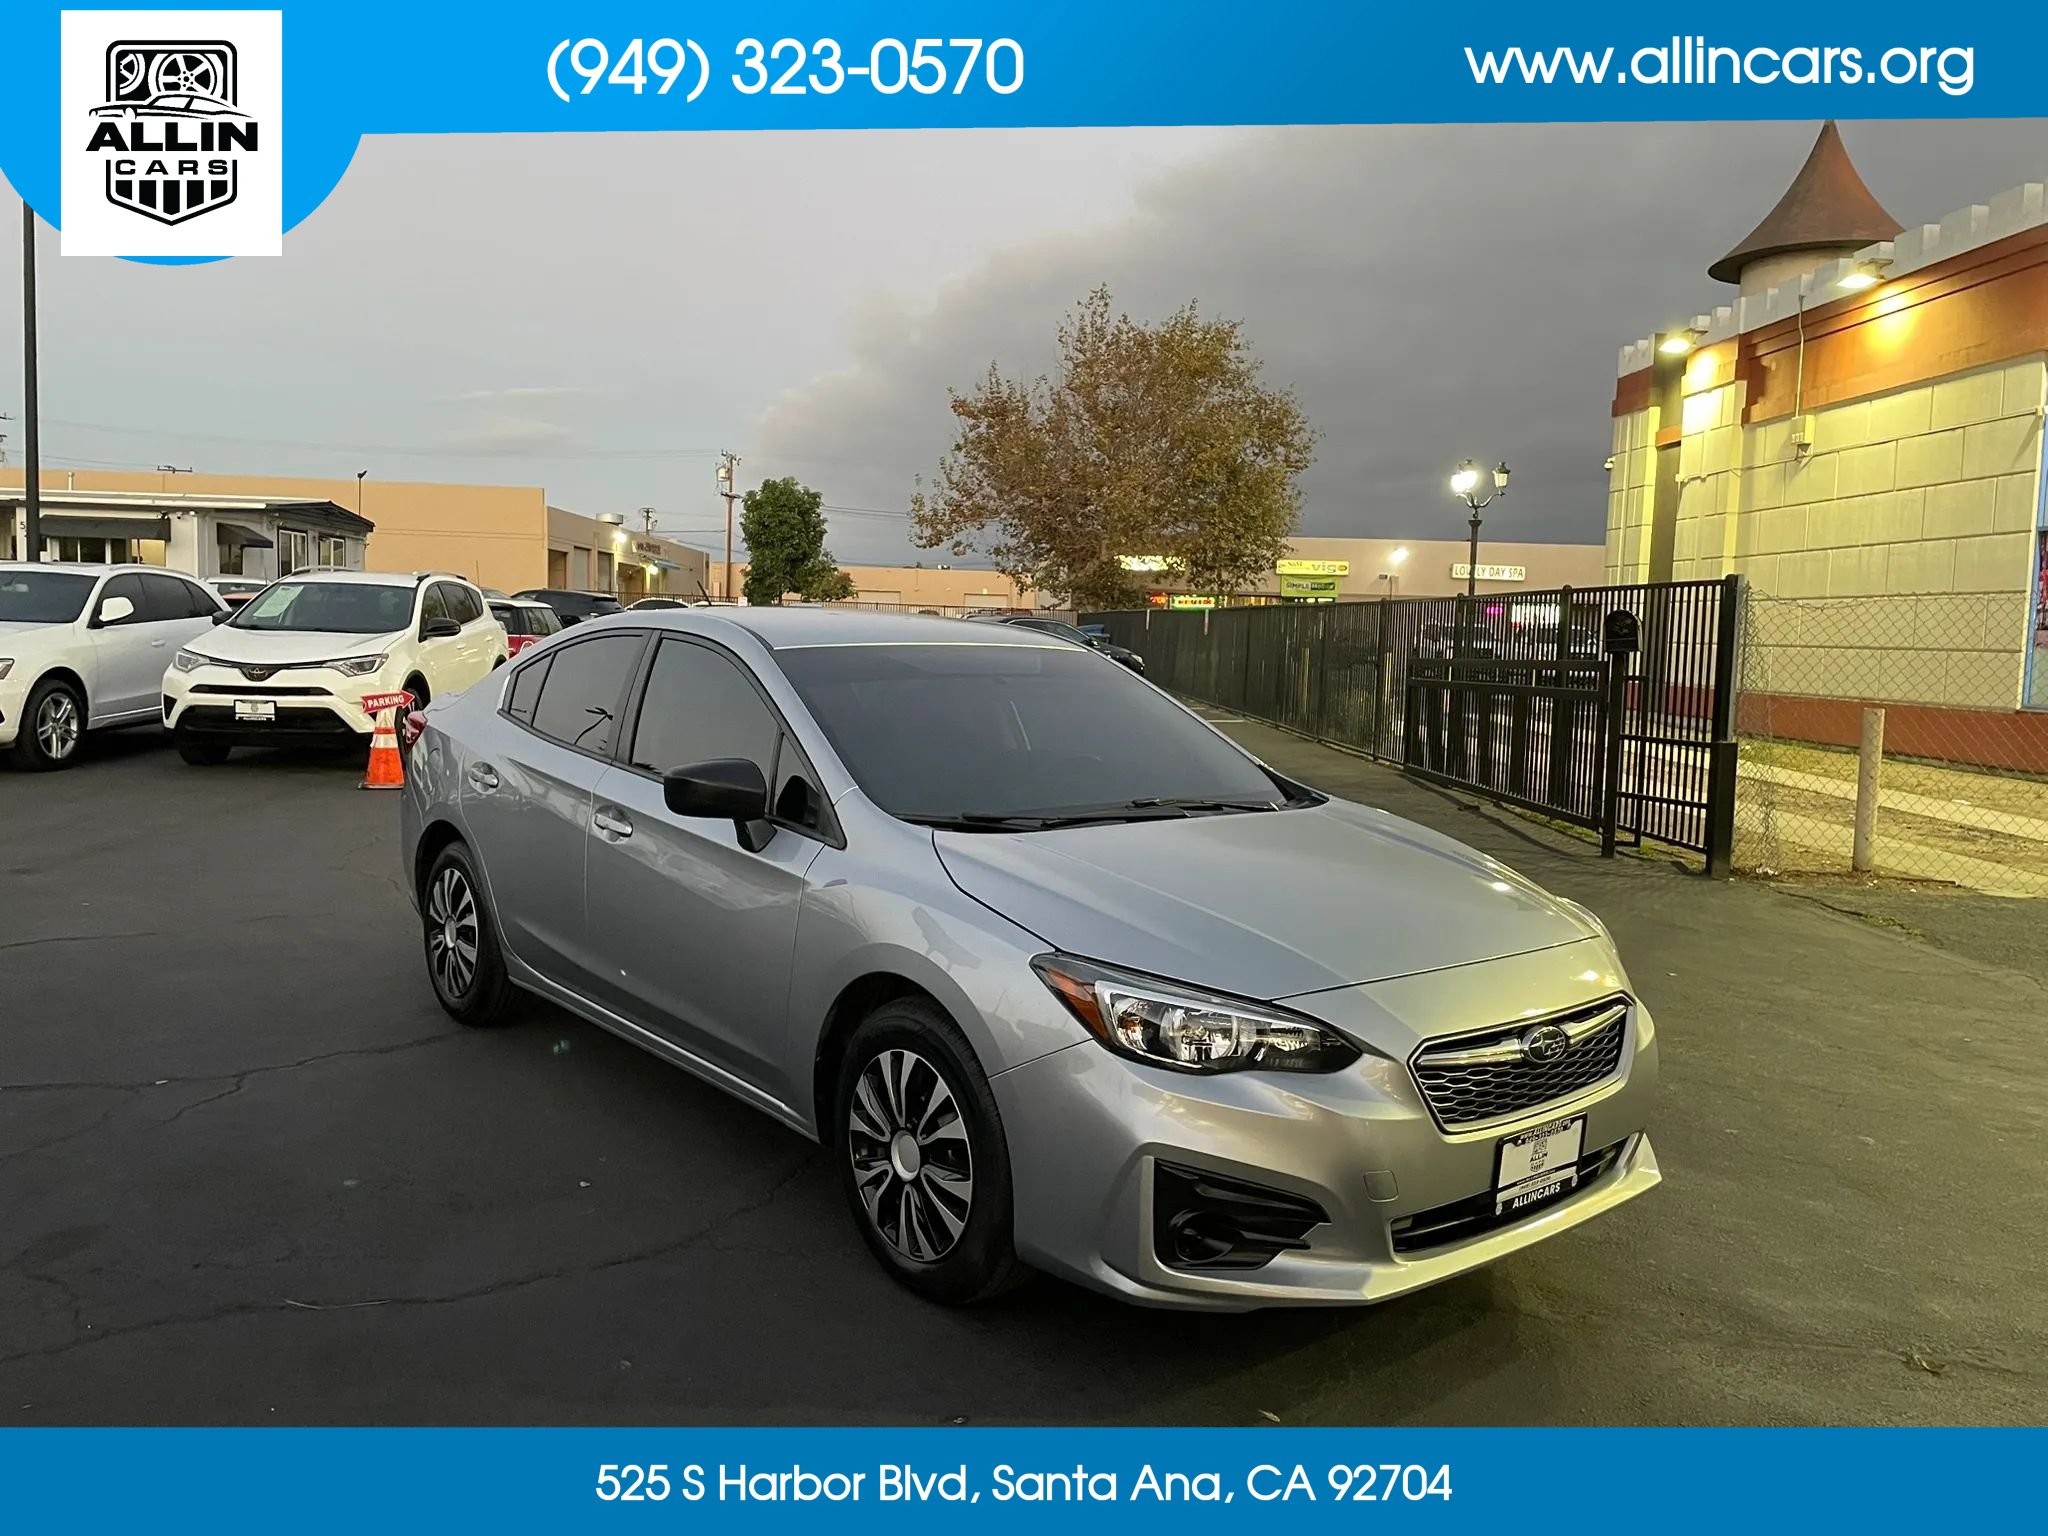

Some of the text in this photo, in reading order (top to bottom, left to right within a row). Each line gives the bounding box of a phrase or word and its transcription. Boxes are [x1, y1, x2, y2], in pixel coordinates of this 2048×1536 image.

[1455, 566, 1523, 578] LOLY DAY SPA
[367, 695, 404, 708] PARKING
[1512, 1182, 1561, 1209] ALLINCARS
